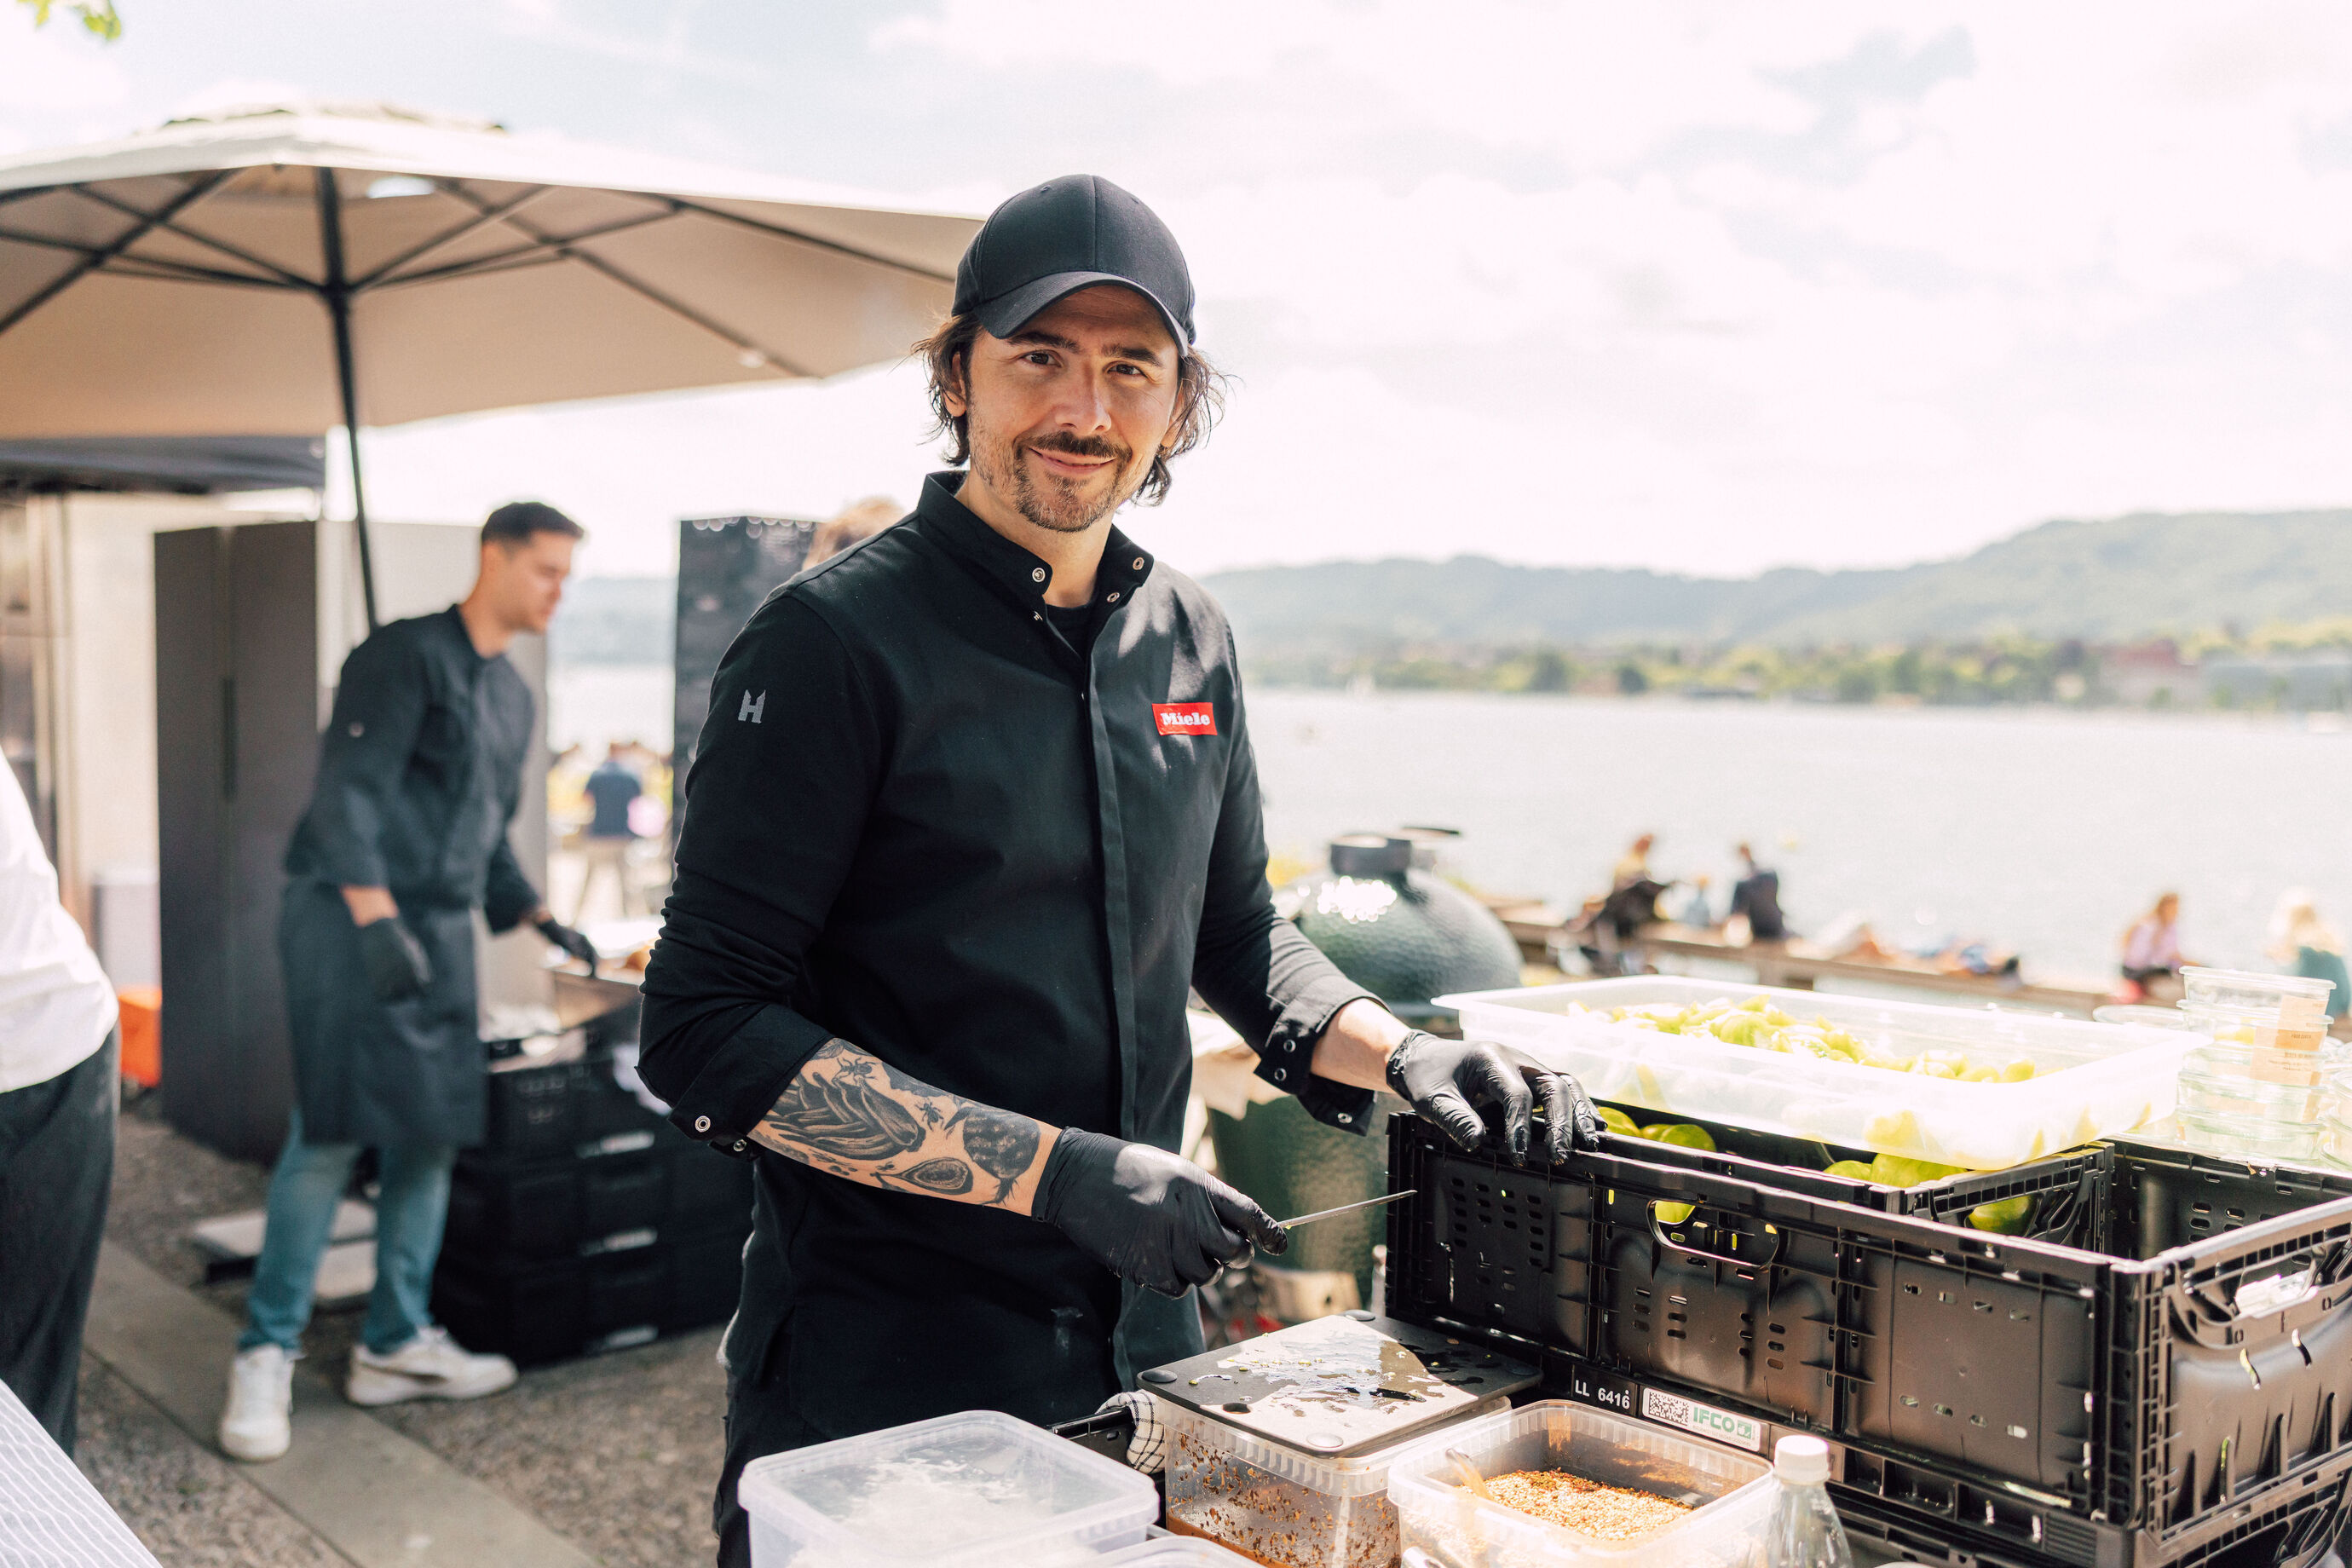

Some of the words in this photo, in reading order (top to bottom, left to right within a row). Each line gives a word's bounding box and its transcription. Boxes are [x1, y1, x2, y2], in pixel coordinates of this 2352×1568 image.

[1160, 712, 1211, 726] Miele
[1575, 1379, 1591, 1398] LL
[1598, 1387, 1631, 1409] 6416
[1692, 1406, 1736, 1433] IFCO
